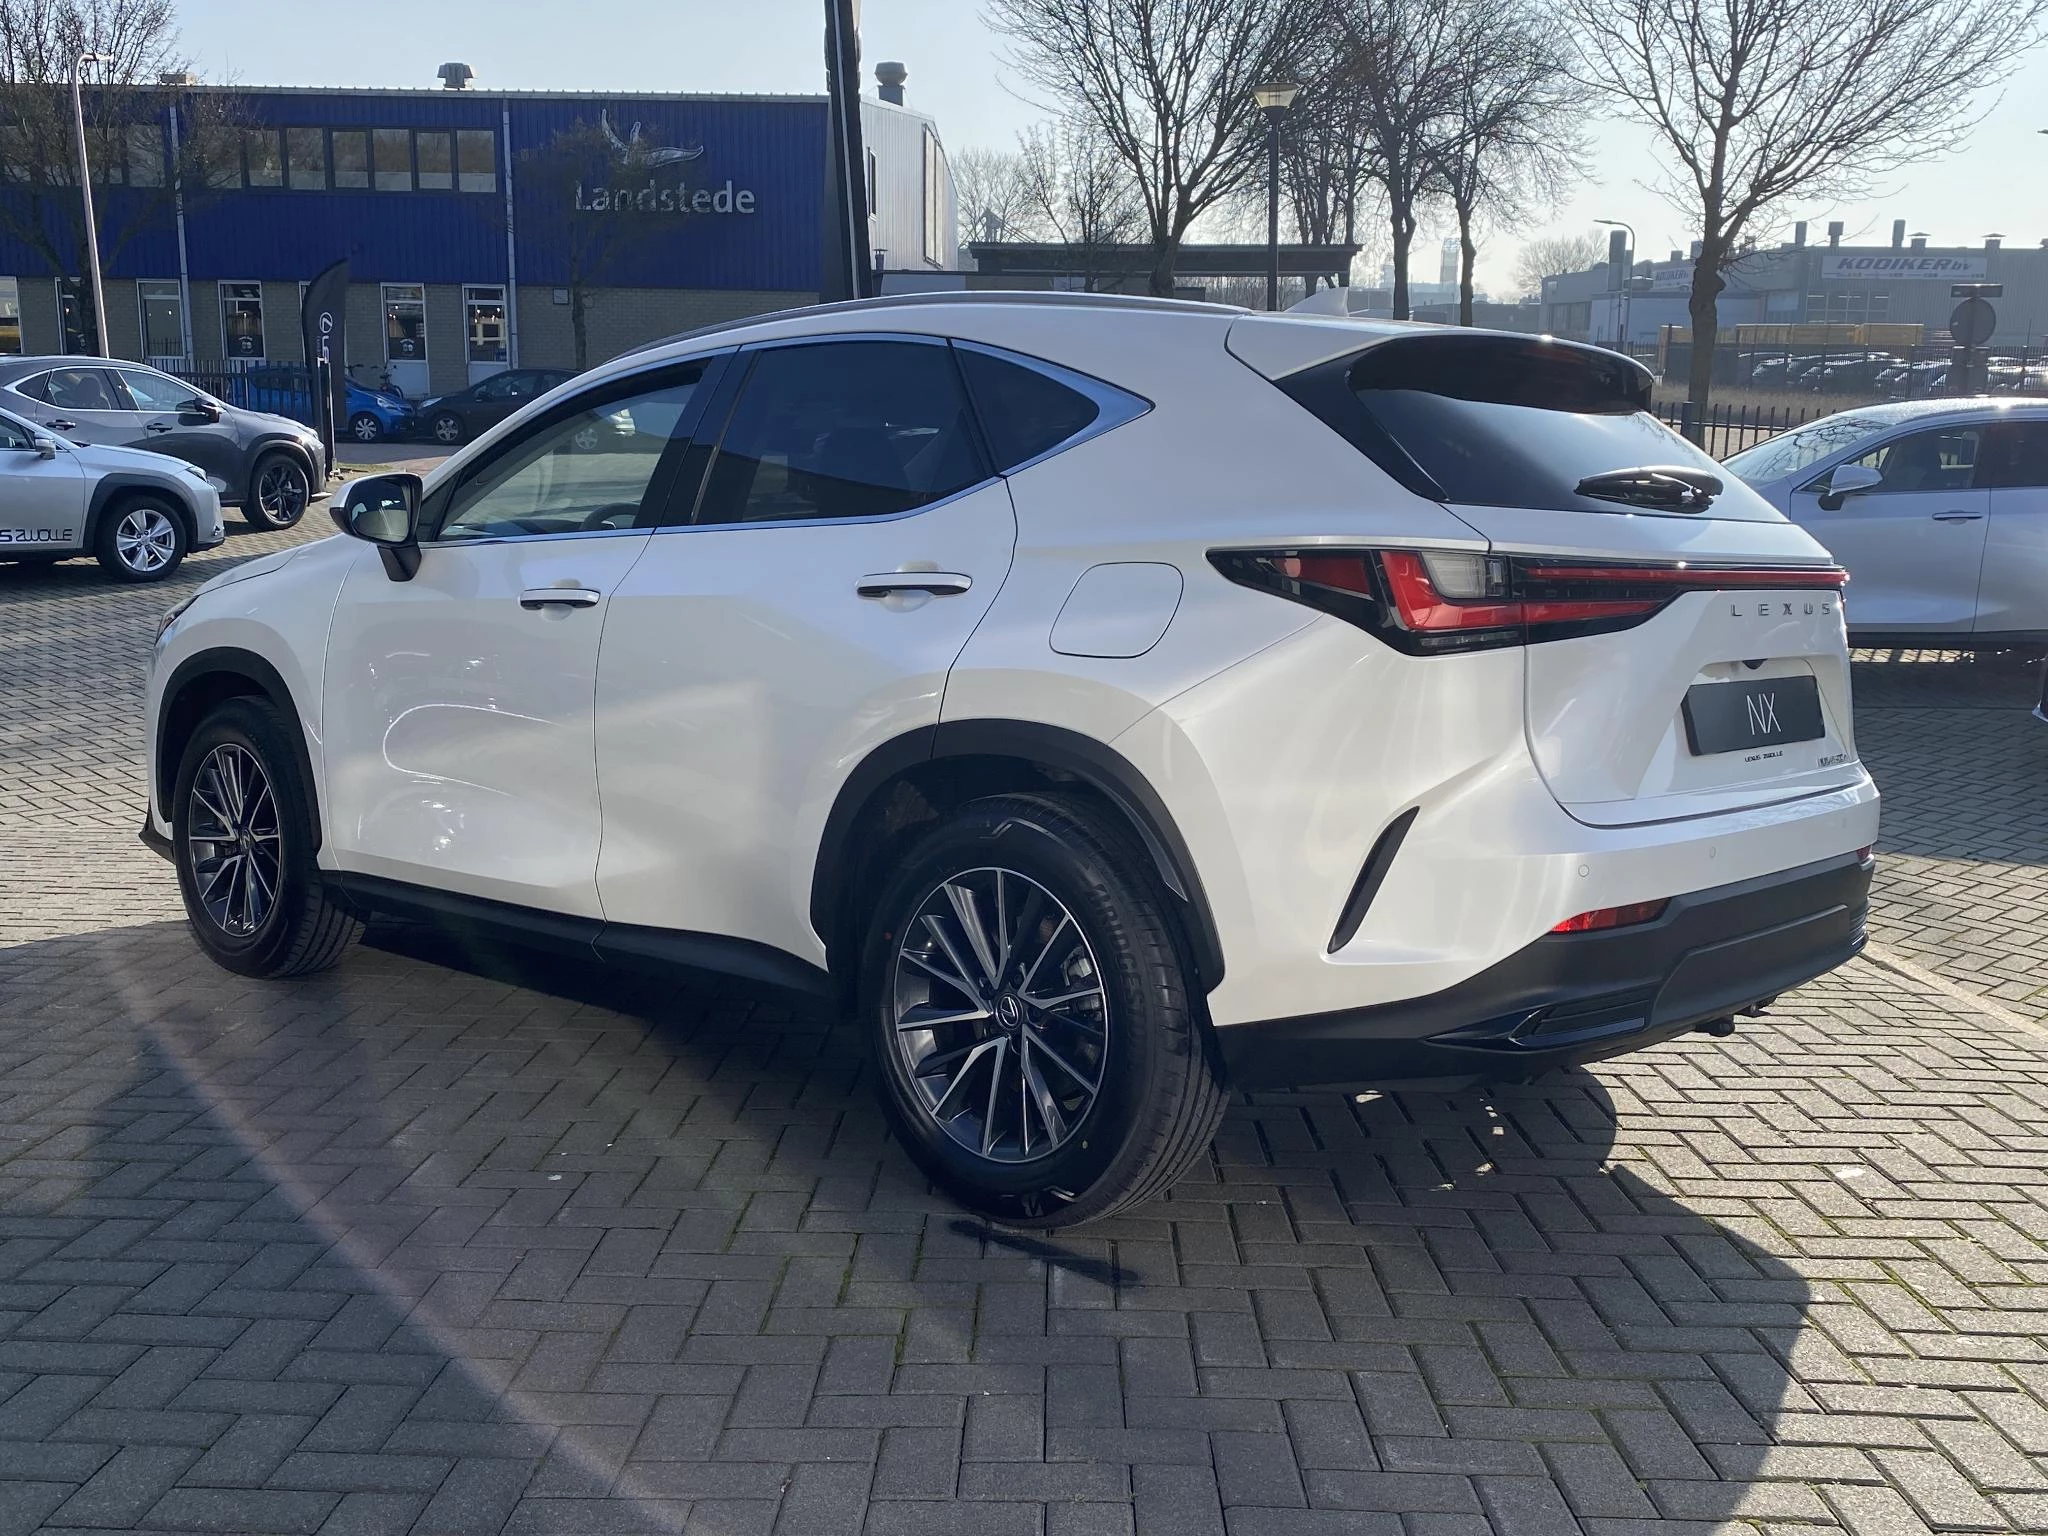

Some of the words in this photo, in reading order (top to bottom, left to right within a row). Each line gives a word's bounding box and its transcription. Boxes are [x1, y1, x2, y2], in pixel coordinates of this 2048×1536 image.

[575, 179, 755, 214] Landstede
[1837, 257, 1950, 271] KOOIKER
[15, 528, 73, 542] ZWOLLE
[1730, 603, 1831, 617] LEXUS
[1746, 692, 1782, 736] NX
